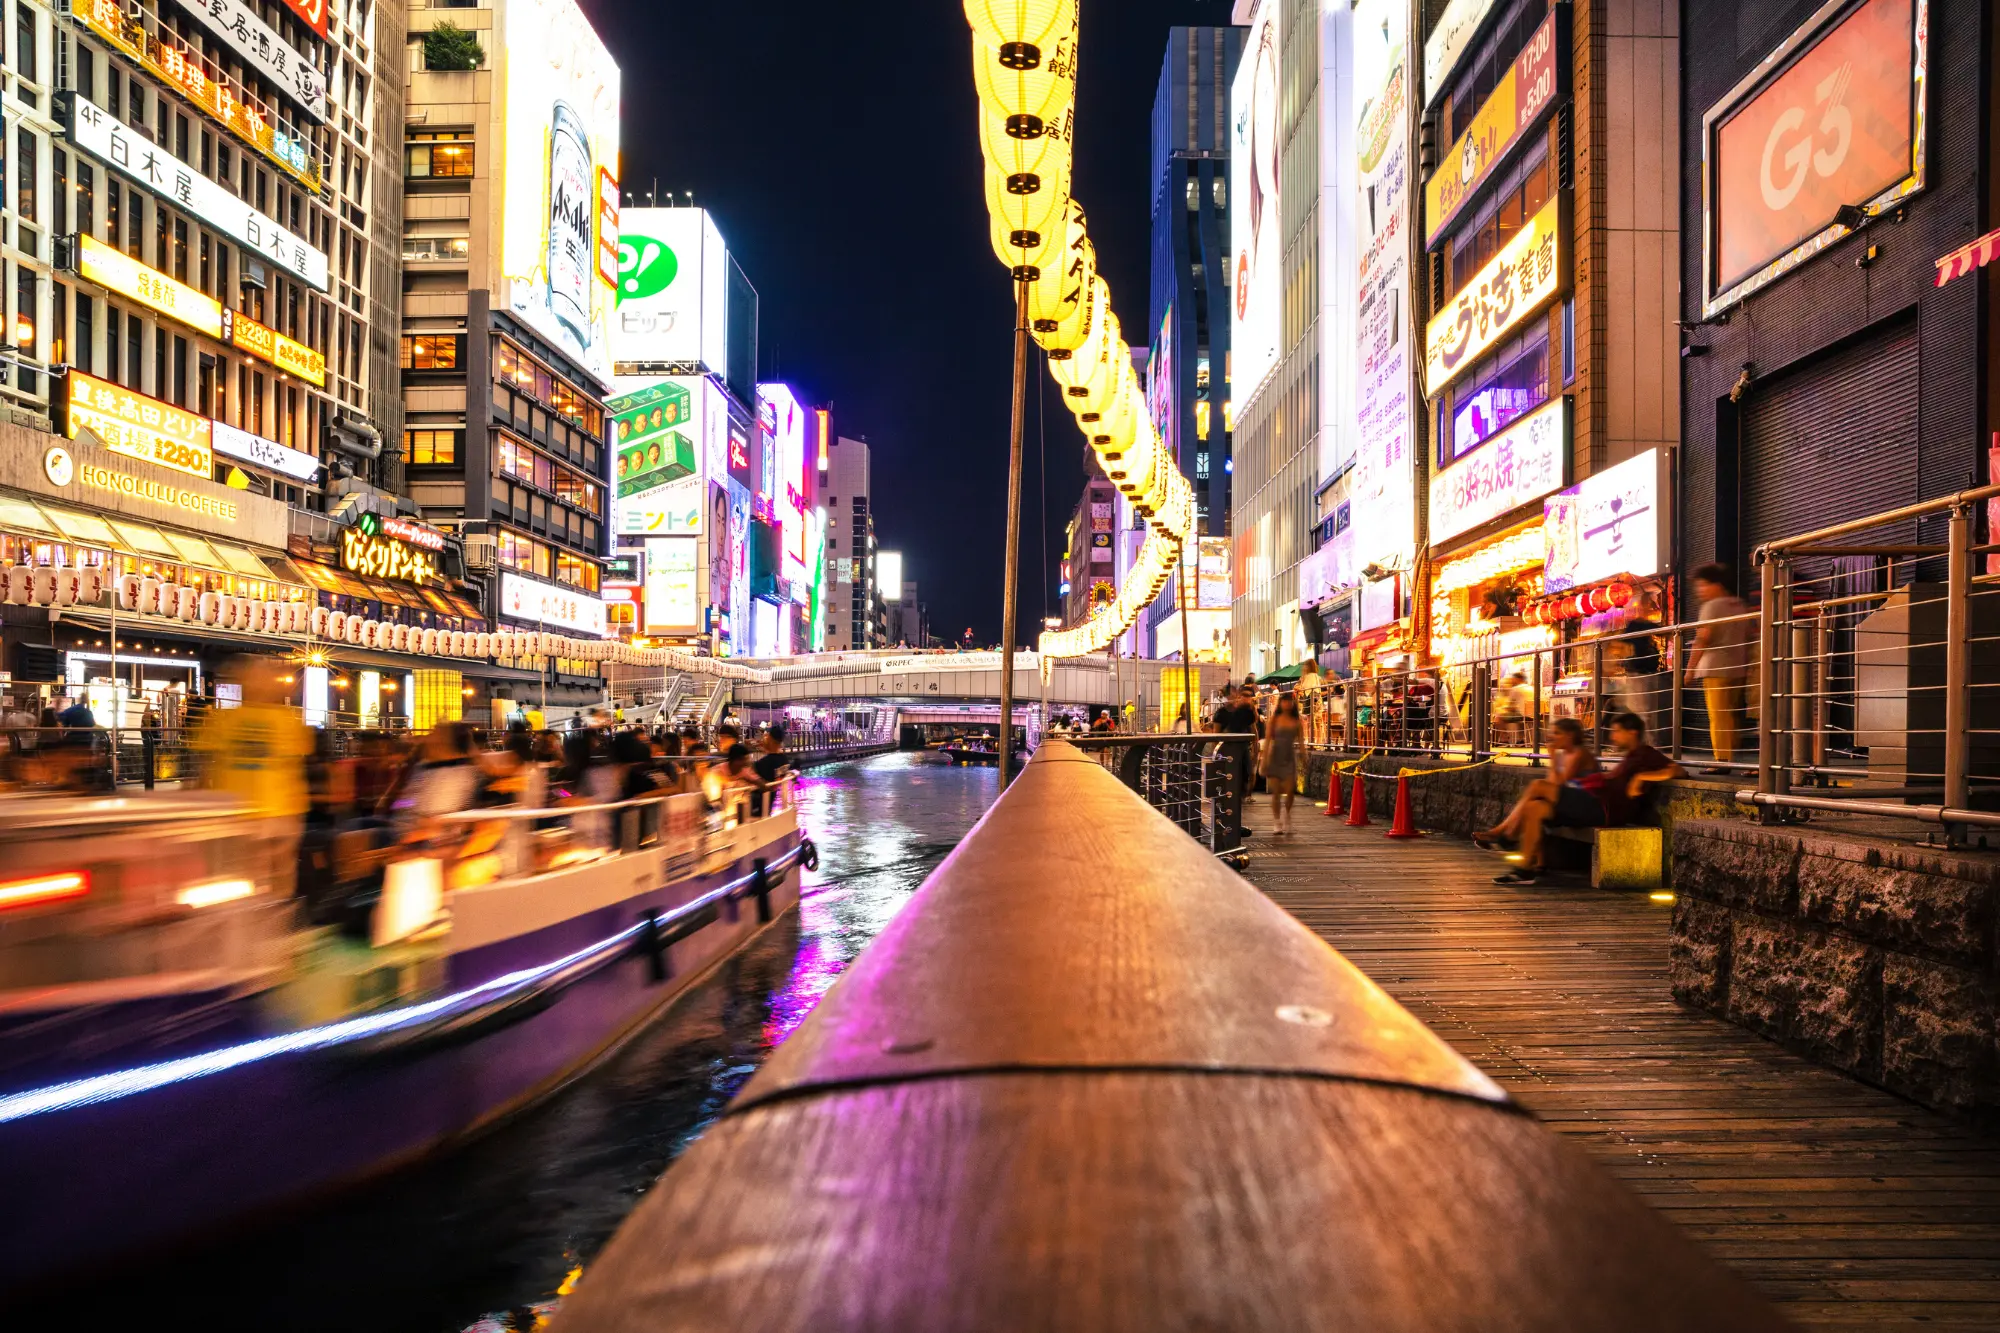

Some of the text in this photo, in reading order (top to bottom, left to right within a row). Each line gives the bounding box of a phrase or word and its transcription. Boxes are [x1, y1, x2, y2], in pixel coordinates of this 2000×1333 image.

[1522, 24, 1550, 79] 17:00
[80, 104, 194, 208] 4F 白木屋
[1760, 60, 1852, 211] G3
[552, 179, 589, 251] Asahi
[247, 213, 309, 277] 白木屋
[224, 309, 232, 340] 3F
[621, 310, 679, 334] ピップ
[1442, 261, 1516, 370] うなぎ
[104, 421, 149, 456] 酒場
[164, 440, 203, 471] 280
[82, 465, 238, 519] HONOLULU COFFEE
[384, 520, 443, 548] ハンバーグレストラン
[626, 511, 683, 531] ミント
[345, 528, 434, 585] びっくりドンキー
